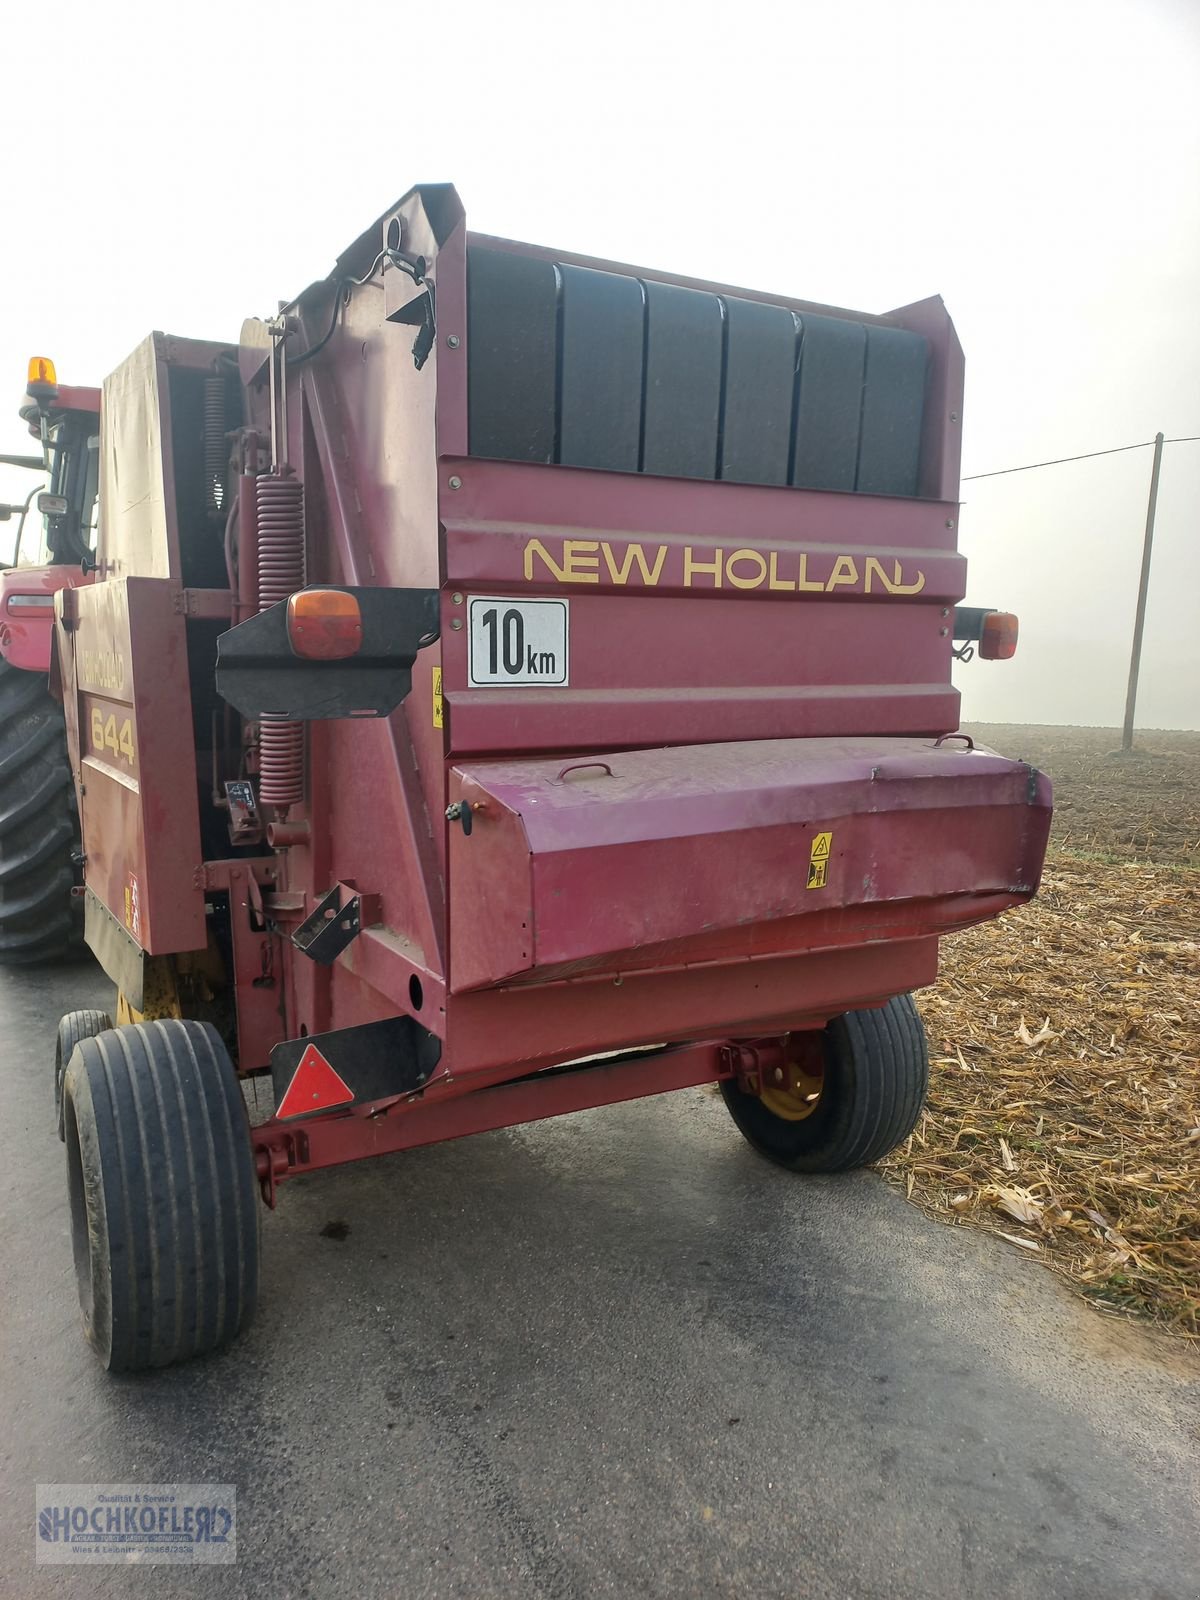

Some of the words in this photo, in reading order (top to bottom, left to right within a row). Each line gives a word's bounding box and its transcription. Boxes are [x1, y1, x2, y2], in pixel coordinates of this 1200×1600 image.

[523, 538, 668, 586] NEW
[683, 547, 926, 595] HOLLAND
[482, 608, 524, 675] 10
[527, 644, 556, 674] km
[91, 707, 134, 765] 644
